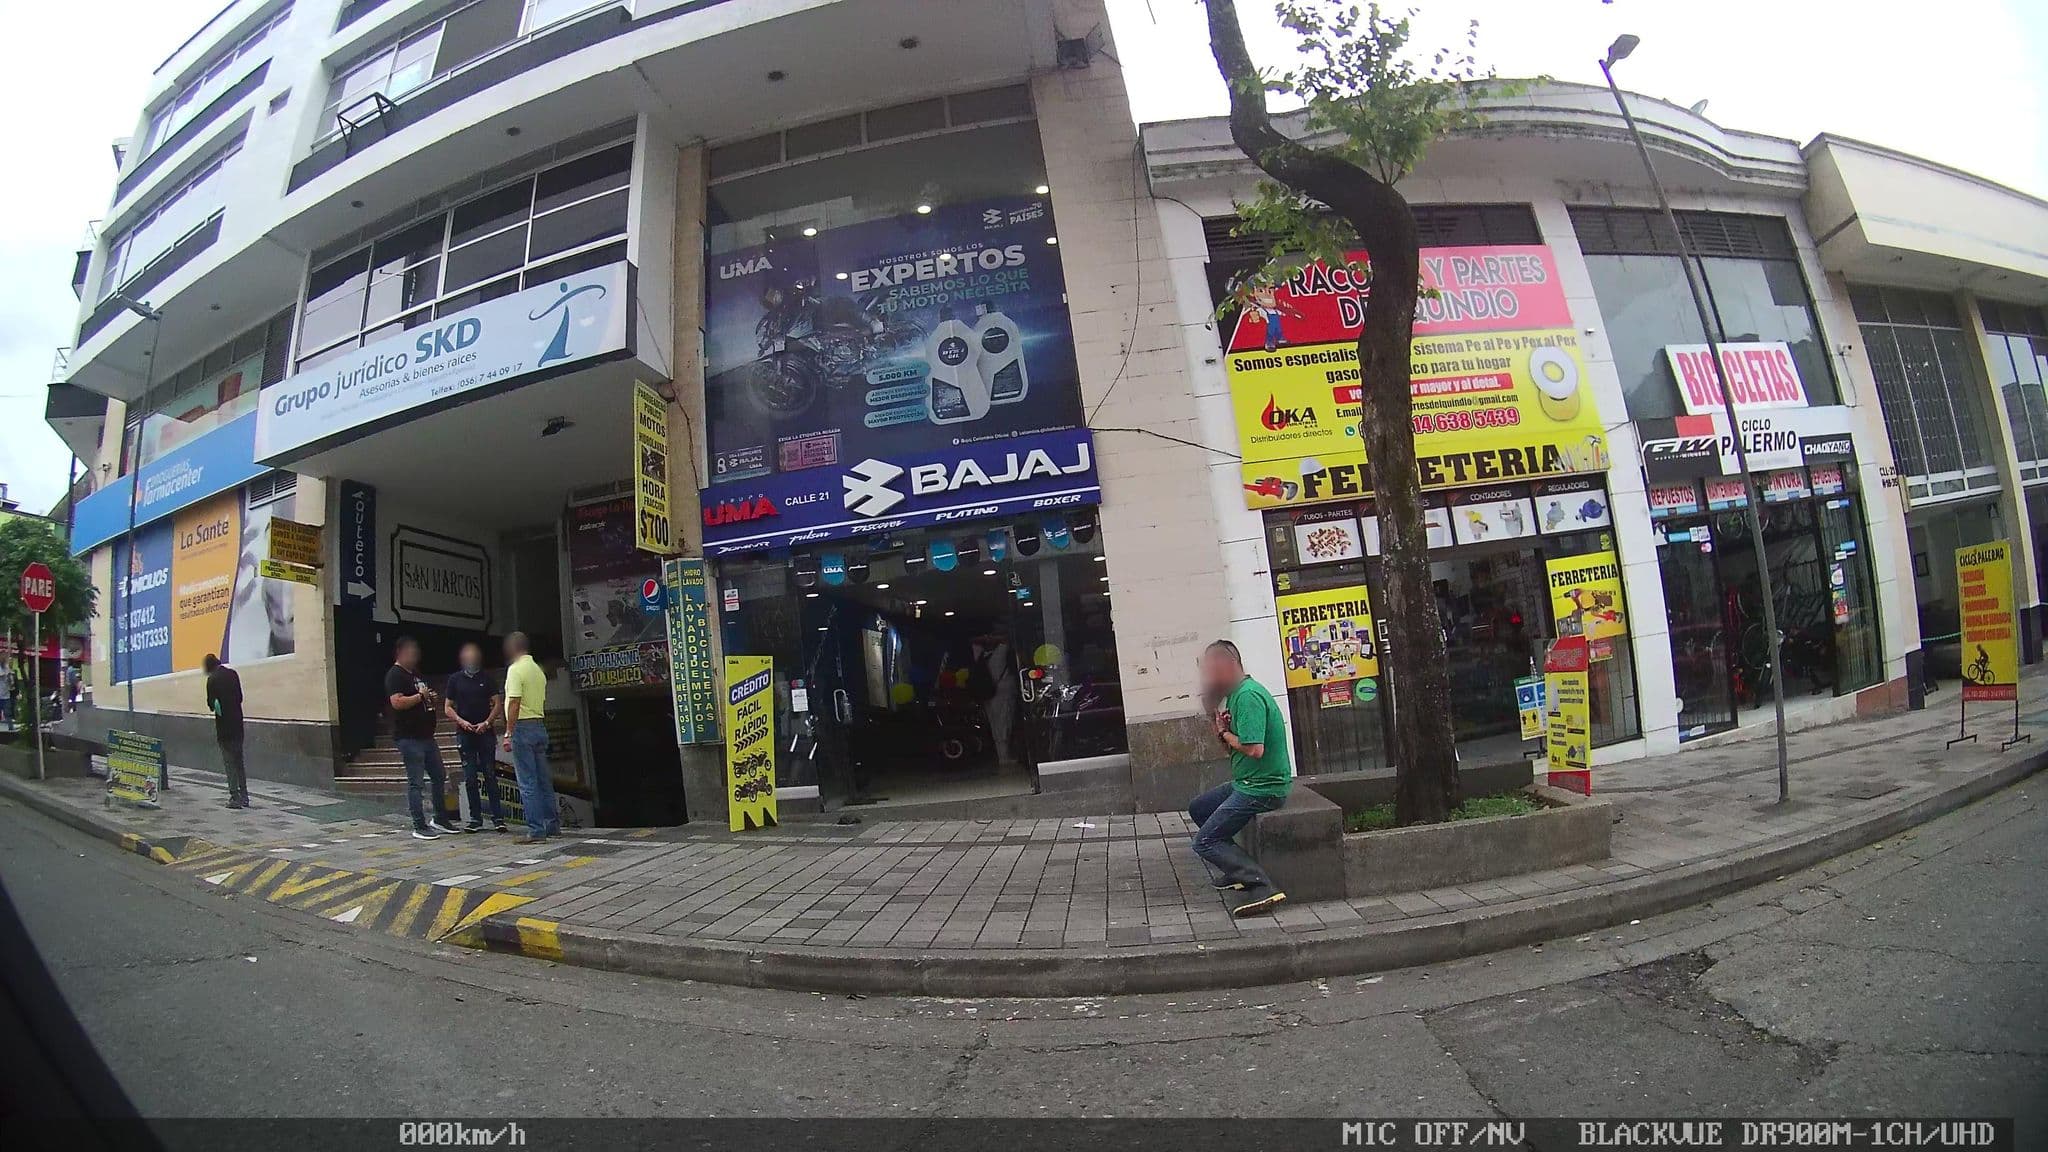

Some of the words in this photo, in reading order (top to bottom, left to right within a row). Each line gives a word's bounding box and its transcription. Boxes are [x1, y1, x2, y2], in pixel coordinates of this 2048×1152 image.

[879, 252, 928, 265] NOSOTROS
[930, 246, 963, 257] SOMOS
[966, 242, 984, 251] LOS
[720, 256, 773, 280] UMA
[851, 244, 1026, 293] EXPERTOS
[1424, 257, 1444, 287] Y
[1451, 254, 1547, 287] PARTES
[889, 277, 966, 299] SABEMOS
[970, 273, 990, 287] LO
[995, 268, 1030, 284] QUE
[877, 300, 899, 314] TU
[903, 293, 949, 311] MOTO
[953, 280, 1031, 300] NECESITA
[1233, 356, 1283, 372] Somos
[1285, 349, 1360, 367] especialis
[1413, 340, 1465, 356] sistema
[1465, 339, 1482, 352] Pe
[1483, 338, 1495, 351] al
[1496, 337, 1512, 350] Pe
[1522, 335, 1543, 348] Pex
[1544, 335, 1555, 347] al
[1557, 334, 1577, 346] Pex
[1430, 360, 1460, 375] para
[1462, 359, 1474, 372] tu
[1476, 356, 1512, 371] hogar
[274, 382, 331, 417] Grupo
[334, 352, 407, 399] jurídico
[415, 317, 482, 364] SKD
[402, 370, 411, 383] &
[413, 361, 445, 380] bienes
[499, 366, 510, 376] 09
[513, 362, 523, 372] 17
[1675, 348, 1800, 407] BICCLETAS
[1419, 380, 1452, 395] mayor
[1462, 378, 1471, 390] al
[639, 412, 666, 438] MOTOS
[1268, 407, 1317, 425] OKA
[1434, 412, 1473, 433] 638
[1472, 407, 1521, 428] 5439
[1741, 418, 1771, 432] CICLO
[1250, 433, 1302, 444] Distribuidores
[1303, 428, 1333, 439] directos
[1721, 431, 1797, 456] PLERMO
[910, 442, 1092, 496] BAJAJ
[1302, 444, 1567, 499] FEETERIA
[641, 477, 666, 502] HORA
[785, 493, 817, 506] CALLE
[818, 491, 830, 501] 21
[1469, 489, 1513, 502] CONTADORES
[1547, 480, 1590, 492] REGULADORES
[1651, 486, 1694, 506] REPUESTOS
[703, 495, 778, 527] UMA
[935, 505, 999, 521] PLATINO
[1033, 494, 1082, 508] BOXER
[640, 507, 669, 547] $700
[1303, 511, 1324, 520] TUBOS
[1328, 509, 1353, 518] PARTES
[180, 531, 193, 550] La
[403, 562, 429, 591] SAN
[432, 567, 481, 601] MARCOS
[682, 578, 704, 586] LAVADO
[684, 568, 701, 577] HIDRO
[823, 565, 844, 574] UMA
[1550, 563, 1618, 588] FERRETERIA
[24, 576, 52, 598] PARE
[685, 593, 698, 654] LAVADO
[1281, 600, 1370, 626] FERRETERIA
[697, 618, 715, 721] BICICLETAS
[731, 673, 769, 701] CRÉDITO
[691, 682, 705, 732] MOTOS
[737, 699, 762, 721] FÁCIL
[735, 713, 768, 741] RÁPIDO
